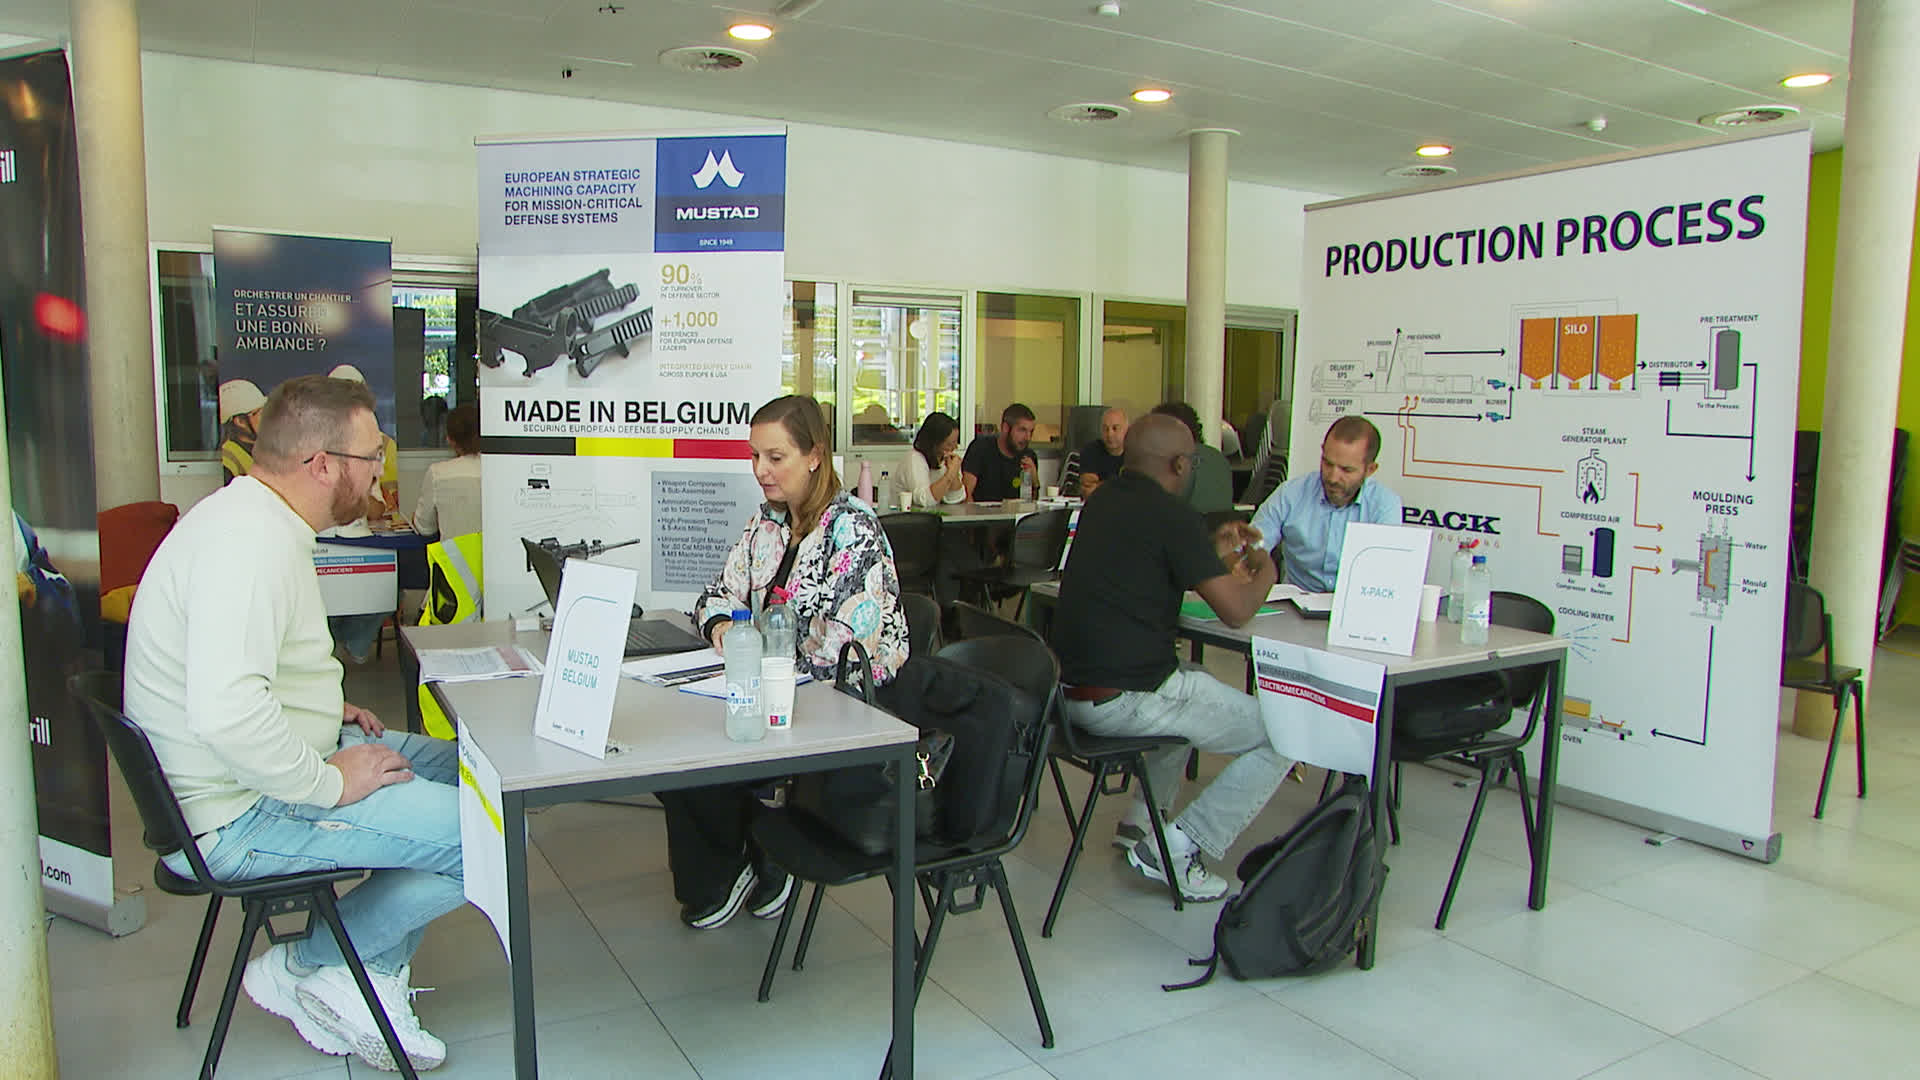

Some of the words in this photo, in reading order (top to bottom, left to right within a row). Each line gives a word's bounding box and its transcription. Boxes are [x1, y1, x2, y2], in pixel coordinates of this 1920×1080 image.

[504, 171, 570, 184] EUROPEAN
[573, 168, 641, 182] STRATEGIC
[504, 184, 573, 198] MACHINING
[576, 183, 636, 196] CAPACITY
[504, 199, 530, 212] FOR
[532, 197, 643, 211] MISSION-CRITICAL
[504, 213, 559, 226] DEFENSE
[561, 211, 619, 225] SYSTEMS
[676, 206, 760, 221] MUSTAD
[699, 239, 718, 247] SINCE
[1325, 220, 1545, 278] PRODUCTION
[1556, 194, 1766, 257] PROCESS
[233, 288, 294, 302] ORCHESTRER
[294, 292, 308, 302] UN
[235, 302, 254, 316] ET
[235, 319, 268, 334] UNE
[271, 320, 323, 335] BONNE
[660, 311, 719, 330] +1,000
[1564, 323, 1588, 335] SILO
[235, 336, 314, 351] AMBIANCE
[318, 338, 327, 351] ?
[1648, 361, 1694, 369] DISTRIBUTOR
[504, 400, 581, 423] MADE
[590, 401, 615, 423] IN
[624, 401, 750, 425] BELGIUM
[523, 424, 567, 433] SECURING
[569, 424, 616, 434] EUROPEAN
[618, 425, 657, 435] DEFENSE
[659, 426, 695, 436] SUPPLY
[696, 427, 730, 436] CHAINS
[1581, 427, 1606, 436] STEAM
[1561, 436, 1603, 445] GENERATOR
[1604, 437, 1628, 446] PLANT
[1692, 490, 1754, 505] MOULDING
[1705, 503, 1739, 516] PRESS
[1560, 511, 1607, 523] COMPRESSED
[1608, 516, 1621, 524] AIR
[1744, 541, 1768, 551] Water
[1742, 578, 1768, 589] Mould
[1360, 585, 1395, 600] X-PACK
[1742, 587, 1759, 596] Part
[1558, 606, 1590, 618] COOLING
[1591, 611, 1614, 622] WATER
[567, 648, 600, 669] MUSTAD
[562, 668, 598, 689] BELGIUM
[1562, 734, 1583, 745] OVEN
